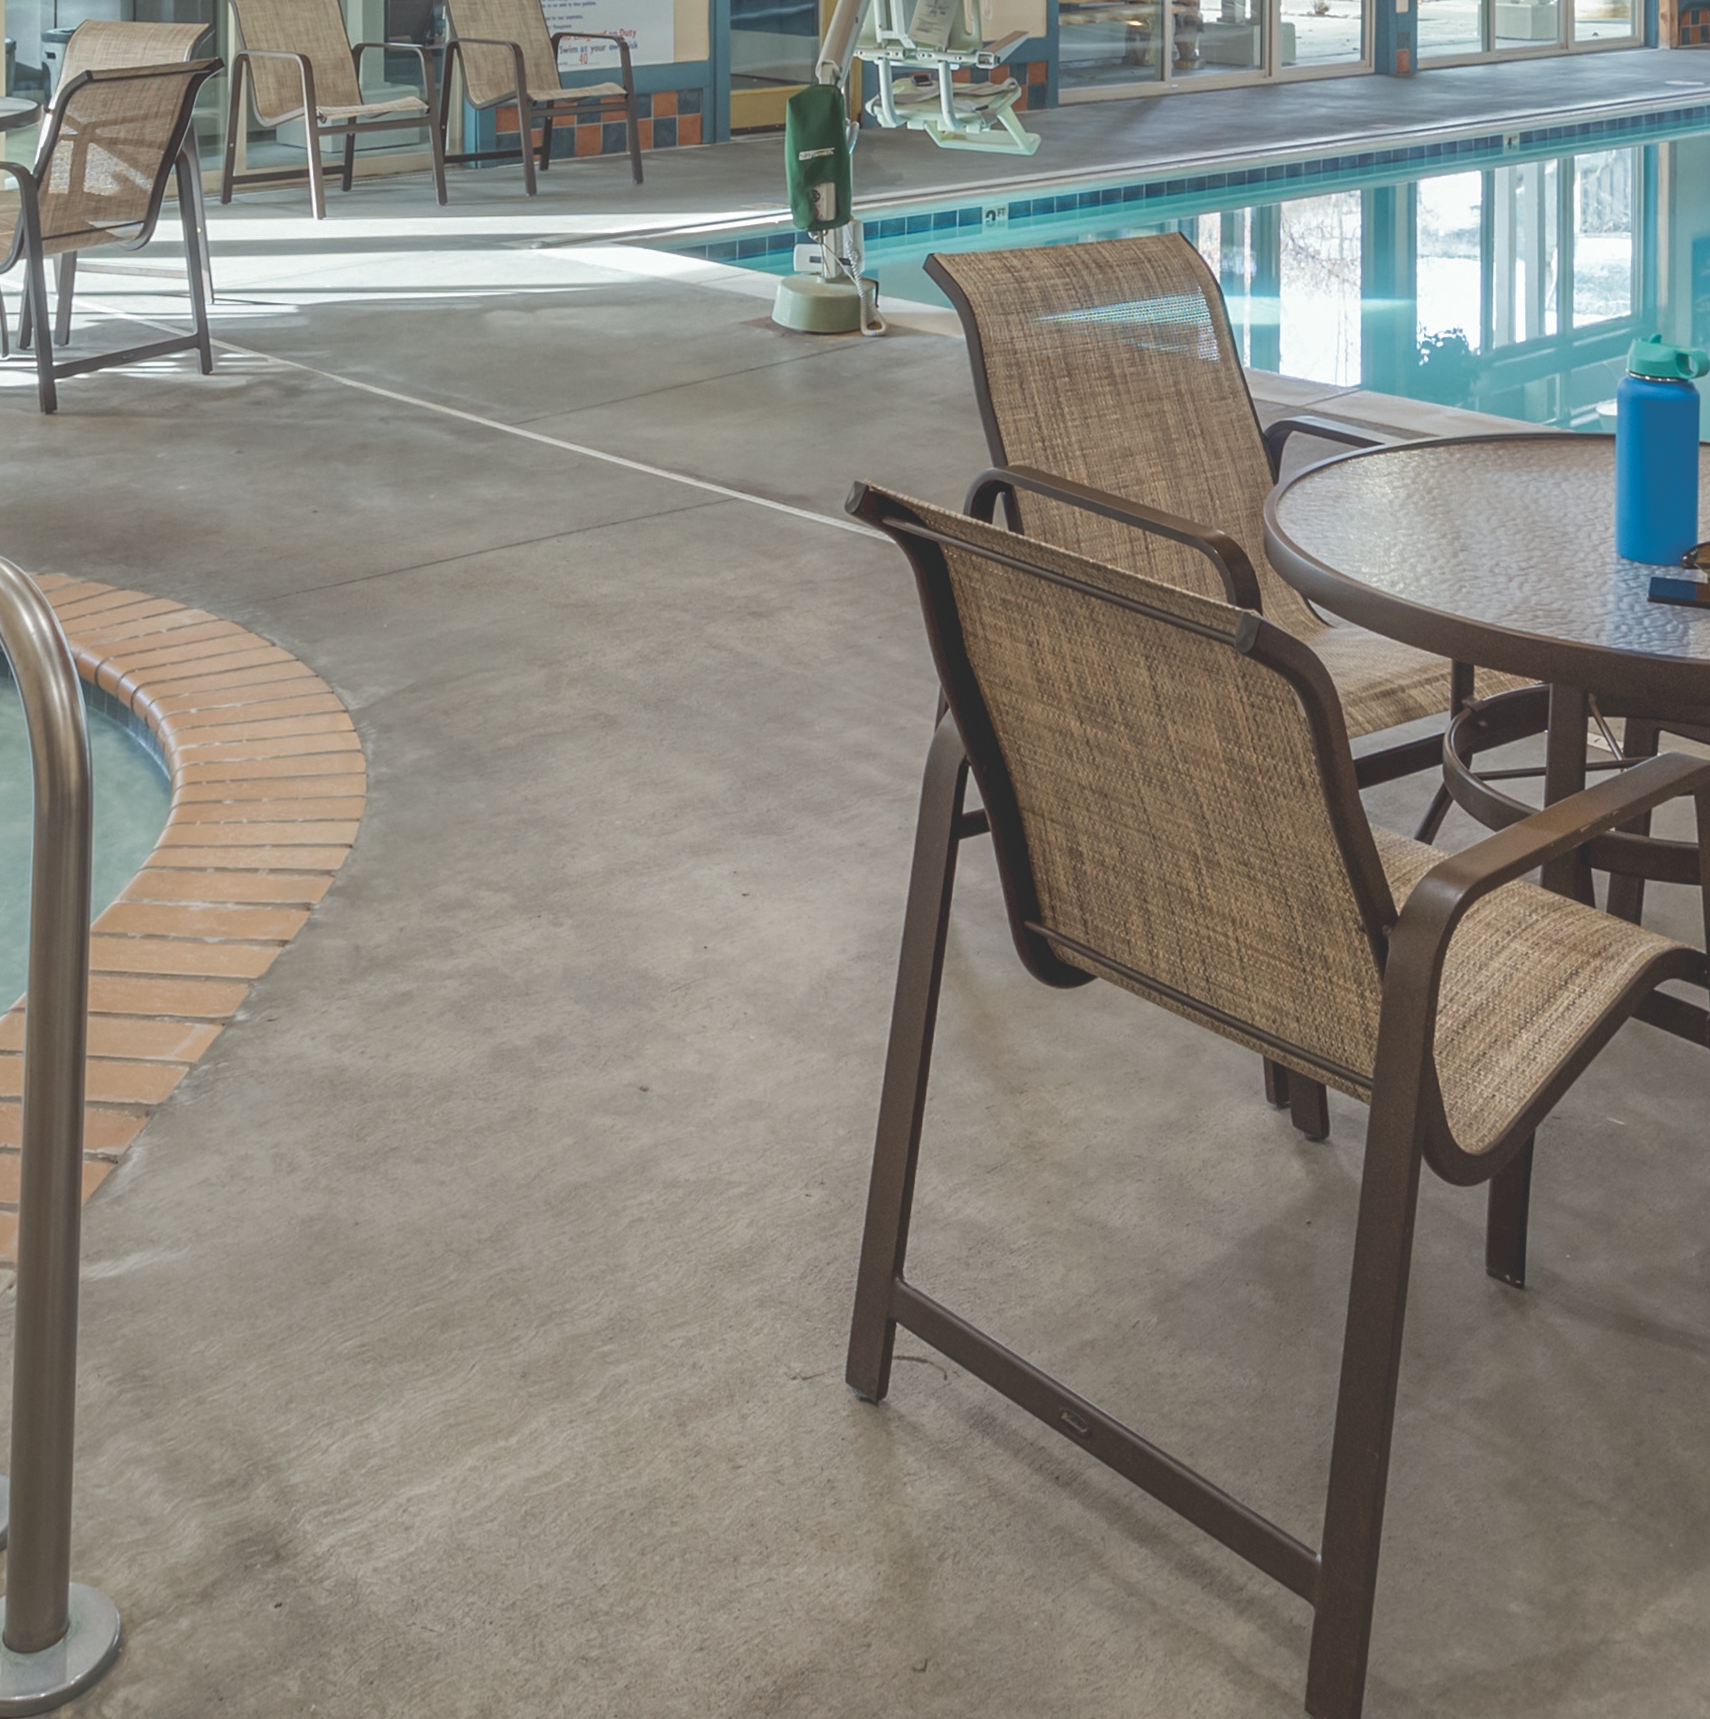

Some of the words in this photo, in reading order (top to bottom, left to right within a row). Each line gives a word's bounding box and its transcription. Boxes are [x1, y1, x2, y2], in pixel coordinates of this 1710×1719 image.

[619, 28, 637, 39] Duty
[559, 45, 578, 54] Swim
[580, 45, 588, 53] at
[590, 44, 606, 54] your
